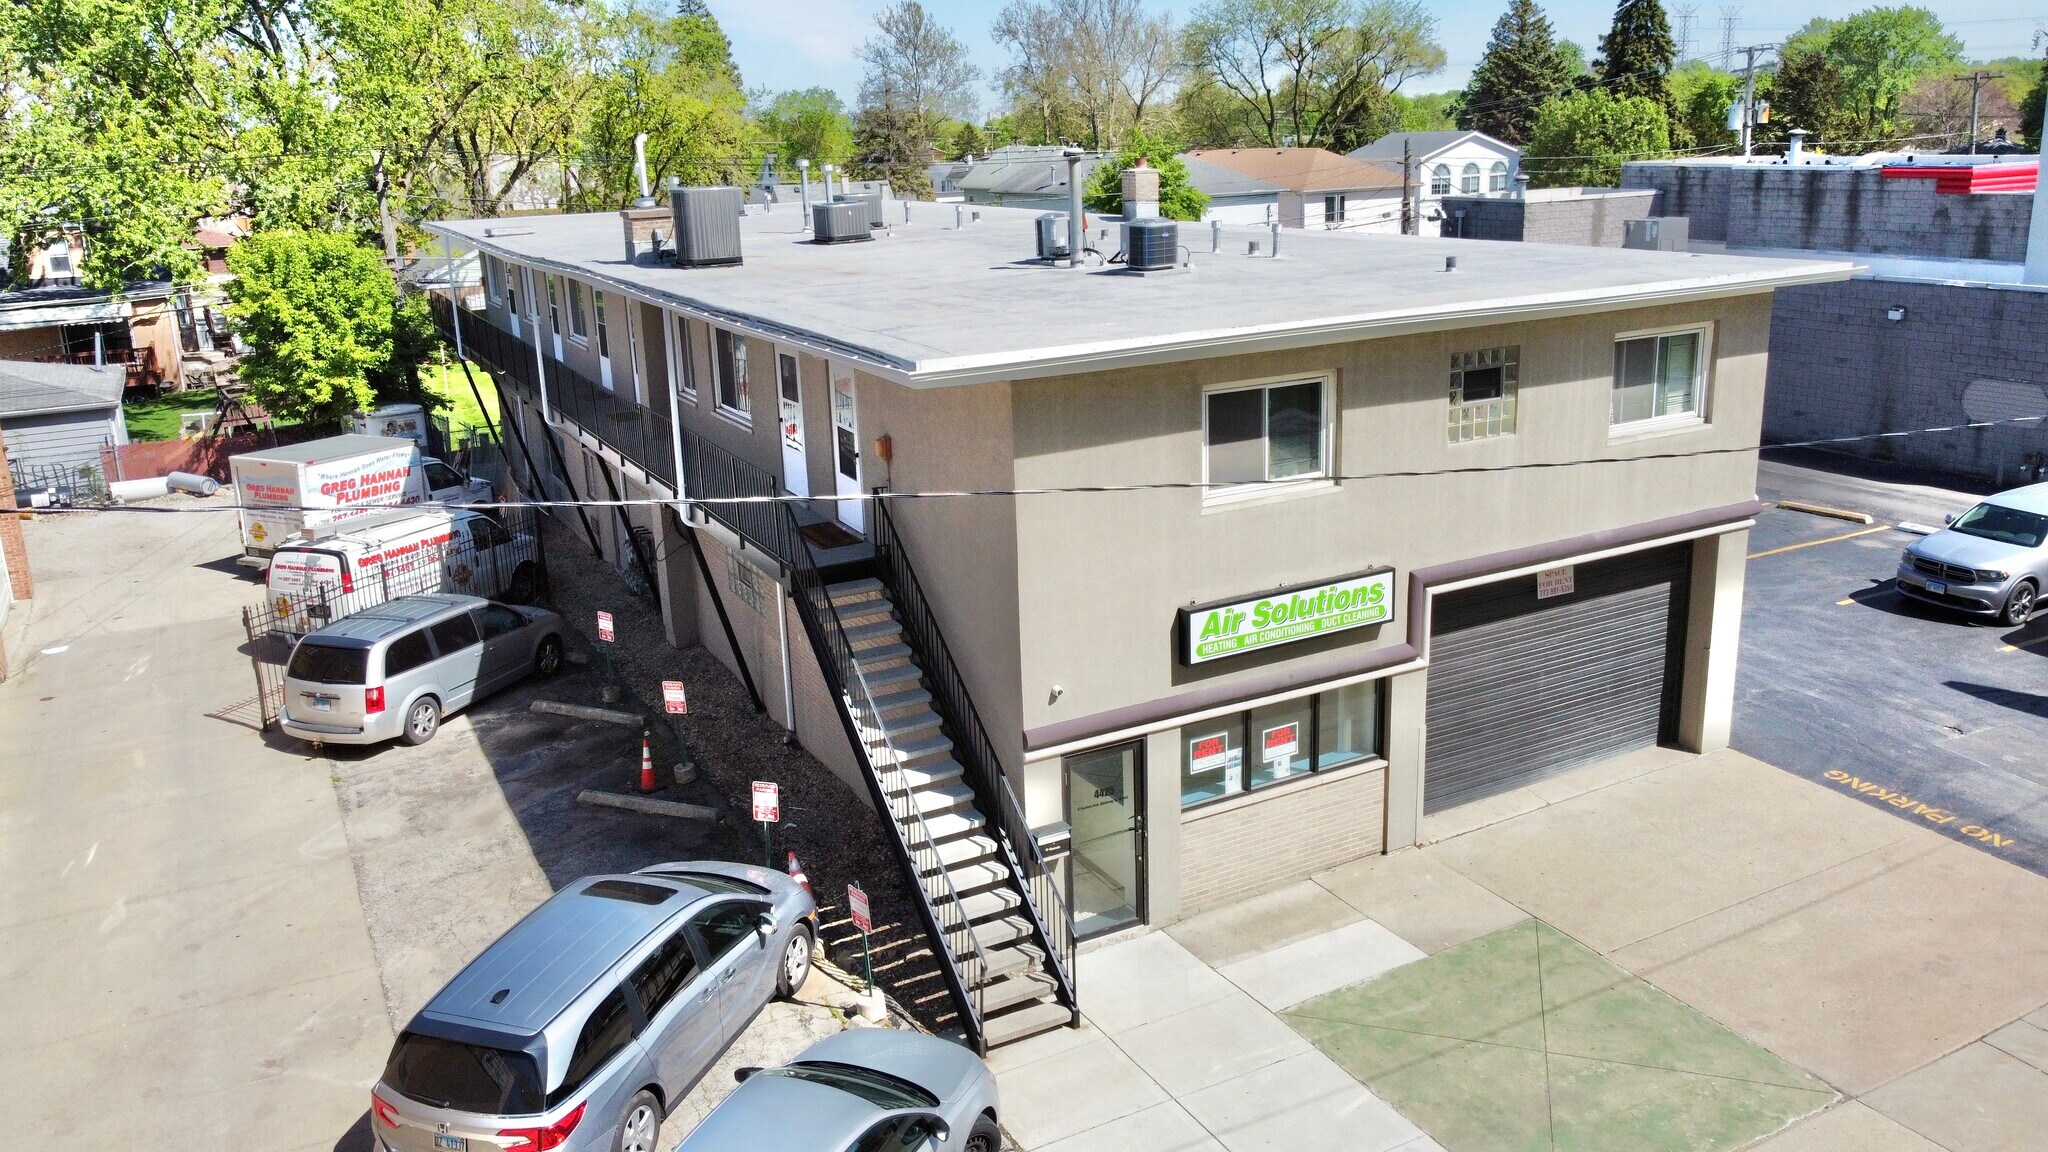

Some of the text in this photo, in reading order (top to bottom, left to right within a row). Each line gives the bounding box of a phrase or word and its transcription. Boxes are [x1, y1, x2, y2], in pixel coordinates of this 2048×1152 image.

[361, 461, 375, 470] Goes
[376, 454, 392, 464] Water
[246, 483, 295, 495] GREG HANNAH
[320, 466, 411, 496] GREG HANNAH
[254, 491, 289, 502] PLUMBING
[336, 480, 401, 506] PLUMBING
[383, 542, 420, 559] HANNAH
[1539, 577, 1572, 589] FOR RENT
[1200, 583, 1385, 640] Air Solutions
[1202, 606, 1380, 655] HEATING AIR CONDITIONING DUCT CLEANING
[1271, 726, 1292, 740] FOR
[1198, 737, 1219, 751] FOR
[1265, 734, 1296, 749] RENT
[1193, 744, 1225, 760] RENT
[1823, 769, 2014, 848] NO PARKING
